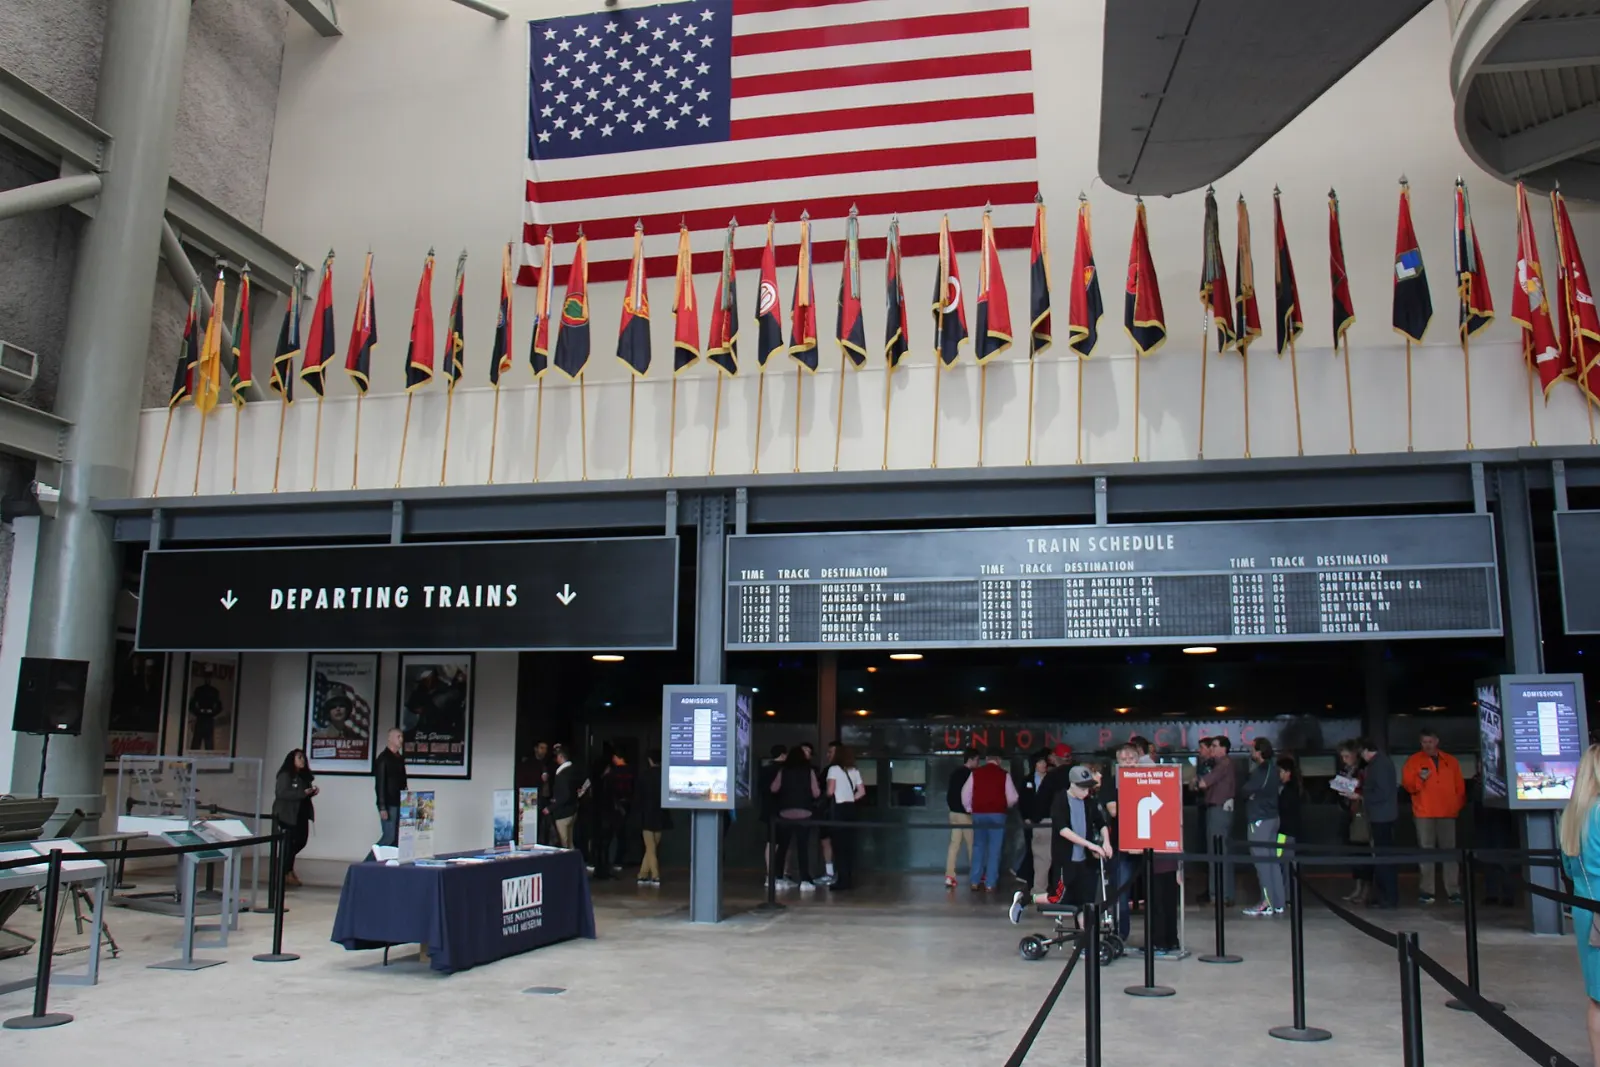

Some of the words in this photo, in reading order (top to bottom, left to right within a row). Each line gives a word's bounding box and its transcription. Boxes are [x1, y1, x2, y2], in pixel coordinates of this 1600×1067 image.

[1027, 538, 1080, 553] TRAIN
[1088, 534, 1175, 552] SCHEDULE
[1230, 558, 1255, 568] TIME
[1270, 556, 1305, 567] TRACK
[1317, 554, 1388, 566] DESTINATION
[740, 570, 764, 579] TIME
[778, 568, 810, 578] TRACK
[821, 566, 888, 578] DESTINATION
[980, 564, 1005, 574] TIME
[1020, 563, 1053, 573] TRACK
[1064, 561, 1134, 572] DESTINATION
[1232, 574, 1263, 583] 01:40
[1272, 574, 1284, 582] 03
[1320, 572, 1363, 581] PHOENIX
[1370, 571, 1382, 580] AZ
[742, 585, 770, 594] 11:05
[779, 585, 790, 594] 06
[822, 584, 864, 593] HOUSTON
[870, 584, 882, 592] TX
[982, 581, 1012, 590] 12:20
[1021, 580, 1032, 589] 02
[1066, 579, 1084, 588] SAN
[1091, 577, 1134, 587] ANTONIO
[1141, 577, 1153, 586] TX
[1232, 584, 1263, 594] 01:55
[1273, 584, 1284, 593] 04
[1320, 582, 1338, 591] SAN
[1345, 581, 1402, 591] FRANCISCO
[1409, 580, 1422, 589] CA
[270, 585, 409, 610] DEPARTING
[423, 584, 518, 608] TRAINS
[742, 595, 770, 604] 11:18
[779, 595, 790, 604] 02
[822, 594, 858, 602] KANSAS
[864, 592, 887, 602] CITY
[893, 592, 906, 601] MO
[982, 591, 1012, 600] 12:33
[1021, 590, 1032, 599] 03
[1066, 589, 1084, 598] LOS
[1091, 588, 1134, 597] ANGELES
[1141, 587, 1154, 596] CA
[1273, 594, 1285, 603] 02
[1320, 592, 1364, 602] SEATTLE
[1371, 592, 1384, 601] WA
[742, 605, 770, 614] 11:30
[779, 605, 790, 613] 03
[822, 603, 863, 612] CHICAGO
[870, 603, 881, 612] IL
[982, 601, 1012, 610] 12:46
[1021, 601, 1032, 609] 06
[1066, 598, 1097, 608] NORTH
[1104, 597, 1141, 607] PLATTE
[1148, 597, 1160, 606] NE
[1233, 605, 1264, 614] 02:24
[1274, 604, 1286, 613] 01
[1321, 603, 1340, 612] NEW
[1346, 602, 1372, 611] YORK
[1378, 602, 1390, 611] NY
[742, 615, 770, 624] 11:42
[779, 614, 790, 623] 05
[822, 613, 864, 622] ATLANTA
[869, 613, 881, 622] GA
[982, 611, 1012, 620] 12:58
[1021, 610, 1032, 619] 04
[1066, 608, 1129, 618] WASHINGTON
[1274, 615, 1286, 624] 06
[1321, 613, 1352, 622] MIAMI
[1360, 613, 1372, 622] FL
[742, 624, 770, 633] 11:55
[779, 624, 790, 632] 01
[821, 623, 857, 632] MOBILE
[863, 623, 875, 632] AL
[982, 621, 1012, 630] 01:12
[1021, 620, 1032, 629] 05
[1068, 618, 1141, 628] JACKSONVILLE
[1149, 617, 1160, 627] FL
[1234, 625, 1265, 634] 02:50
[1275, 625, 1287, 634] 05
[1322, 623, 1360, 632] BOSTON
[1366, 622, 1380, 632] MA
[742, 634, 770, 643] 12:07
[779, 634, 790, 642] 04
[822, 633, 881, 642] CHARLESTON
[887, 632, 900, 641] SC
[982, 631, 1012, 640] 01:27
[1021, 630, 1032, 639] 01
[1067, 628, 1110, 638] NORFOLK
[1117, 628, 1130, 637] VA
[1522, 690, 1563, 698] ADMISSIONS
[944, 729, 1062, 749] UNION
[503, 913, 514, 925] THE
[515, 906, 542, 922] NATIONAL
[503, 924, 519, 936] WWII
[520, 918, 542, 931] MUSEUM
